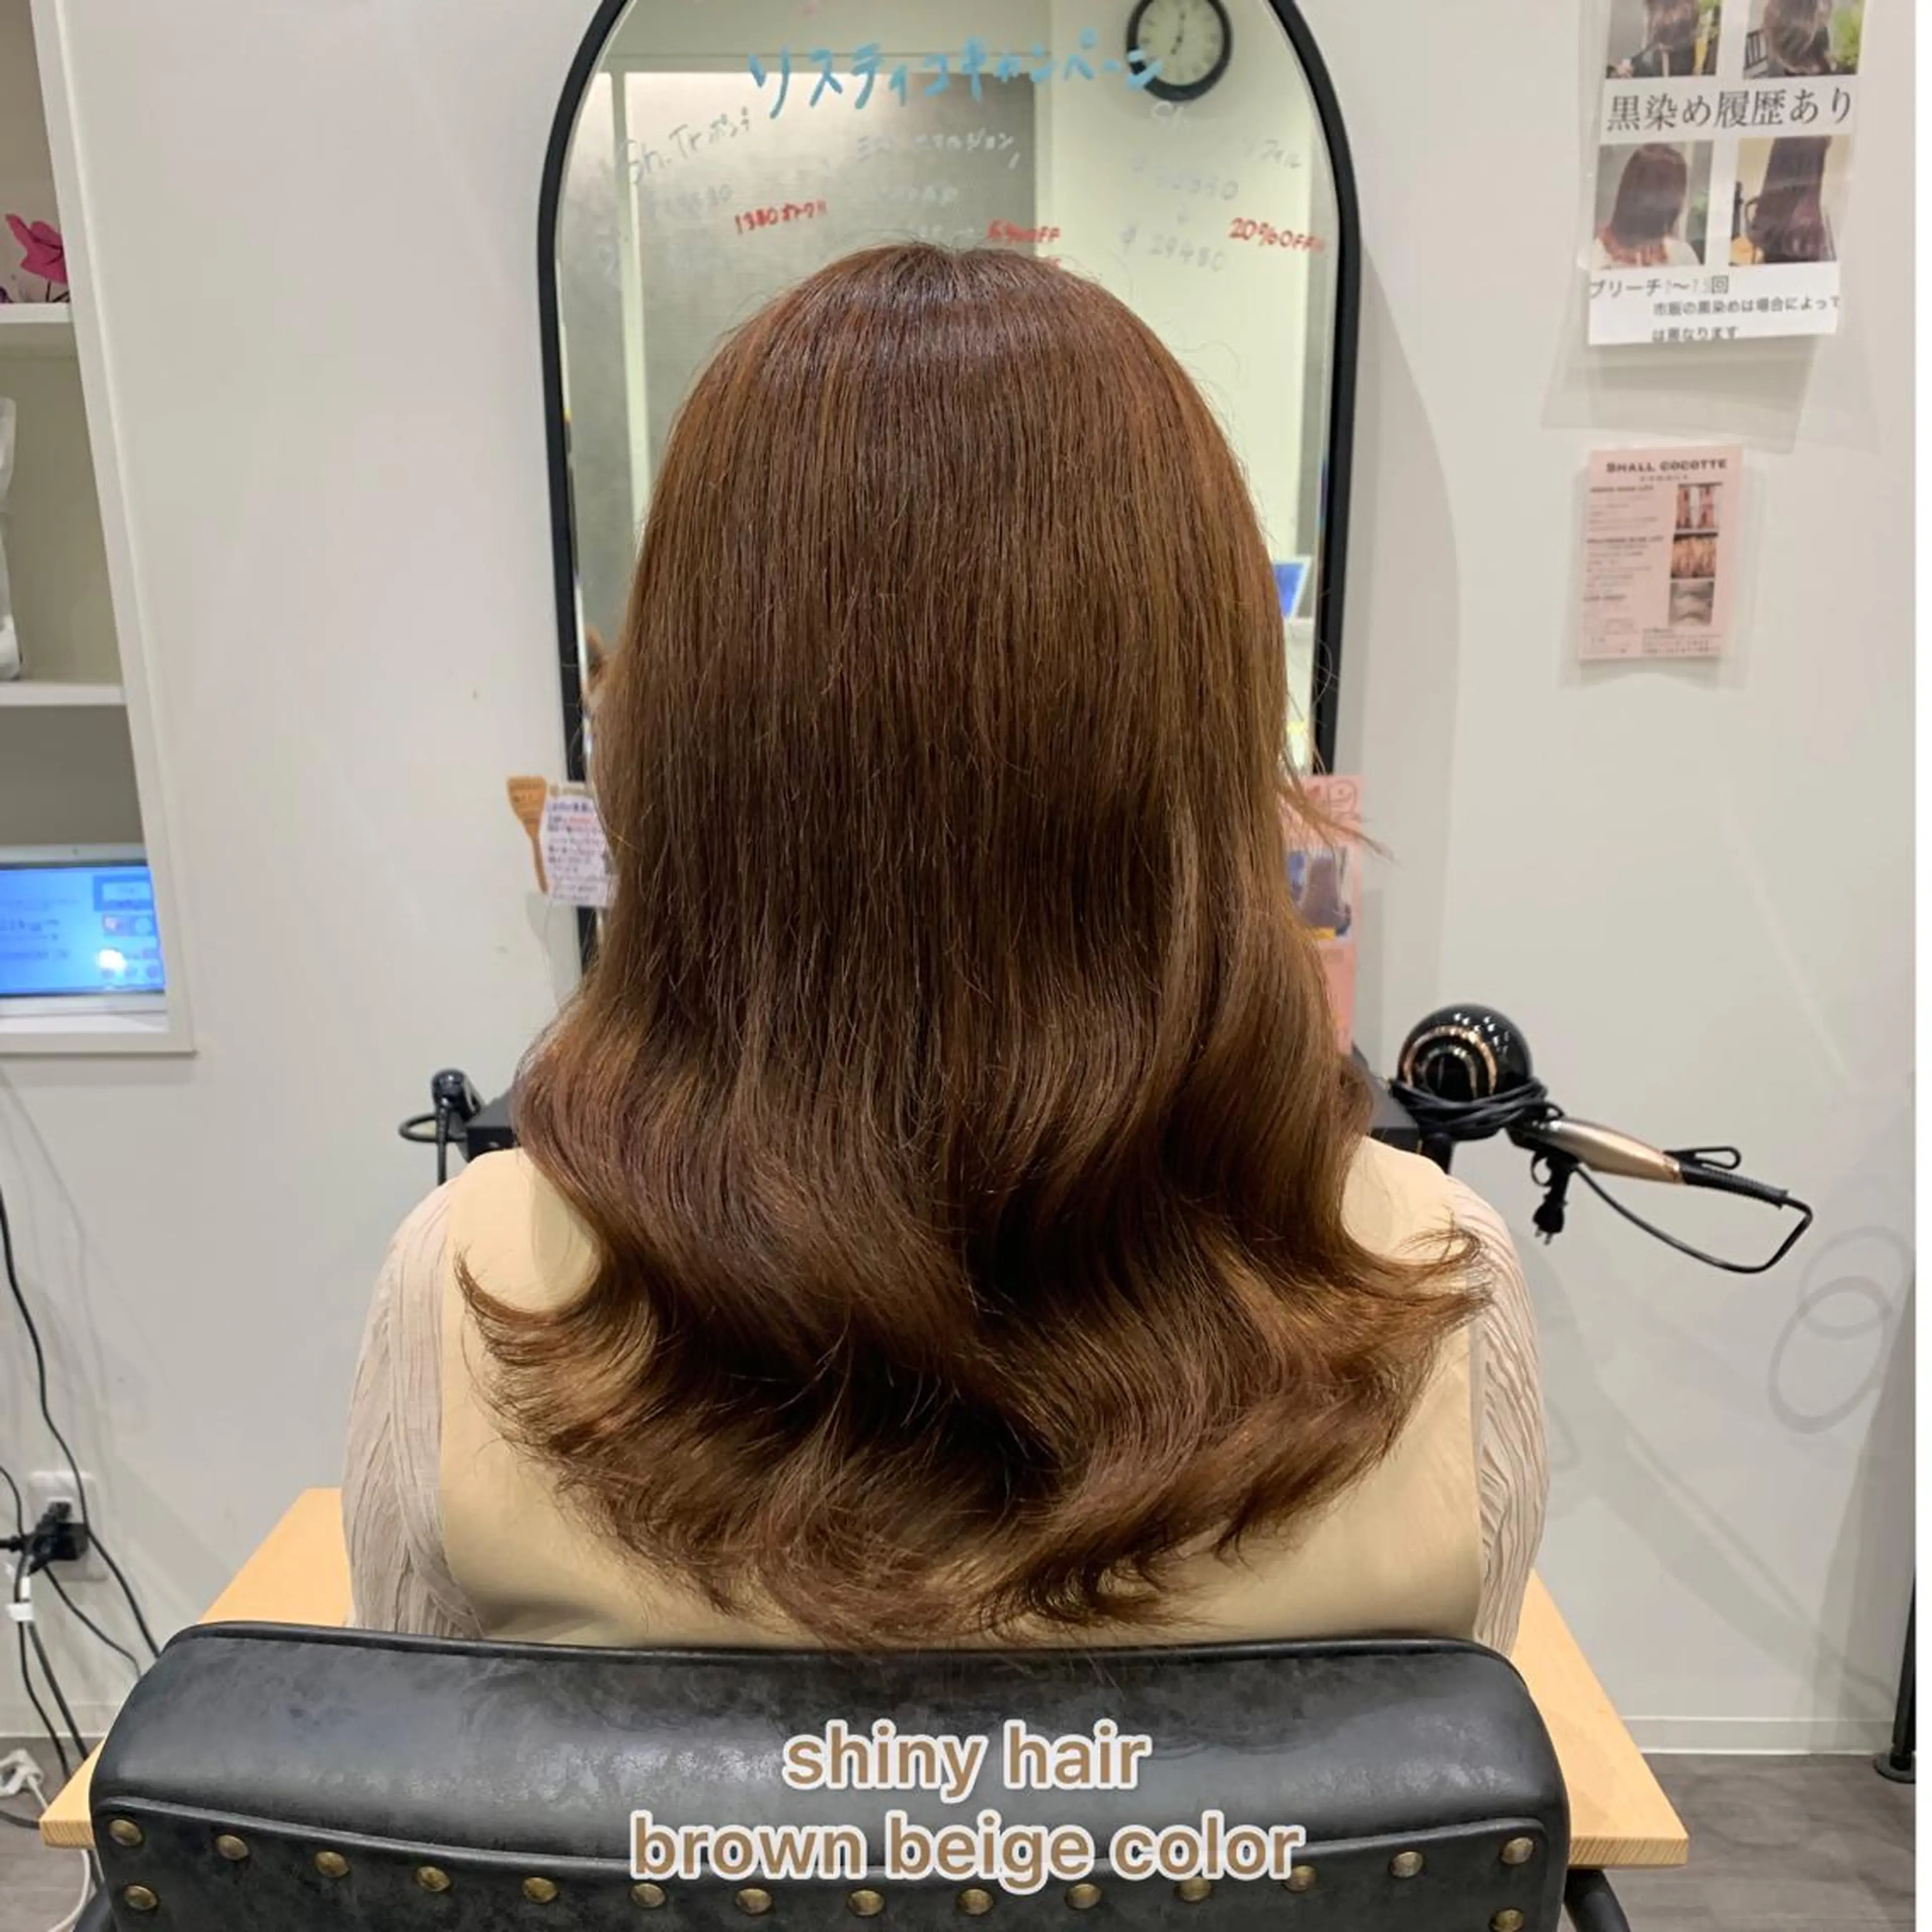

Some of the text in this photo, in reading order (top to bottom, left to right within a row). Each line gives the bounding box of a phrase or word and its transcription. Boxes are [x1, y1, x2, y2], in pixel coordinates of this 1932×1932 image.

[1607, 88, 1852, 132] 黒染め履歴あり
